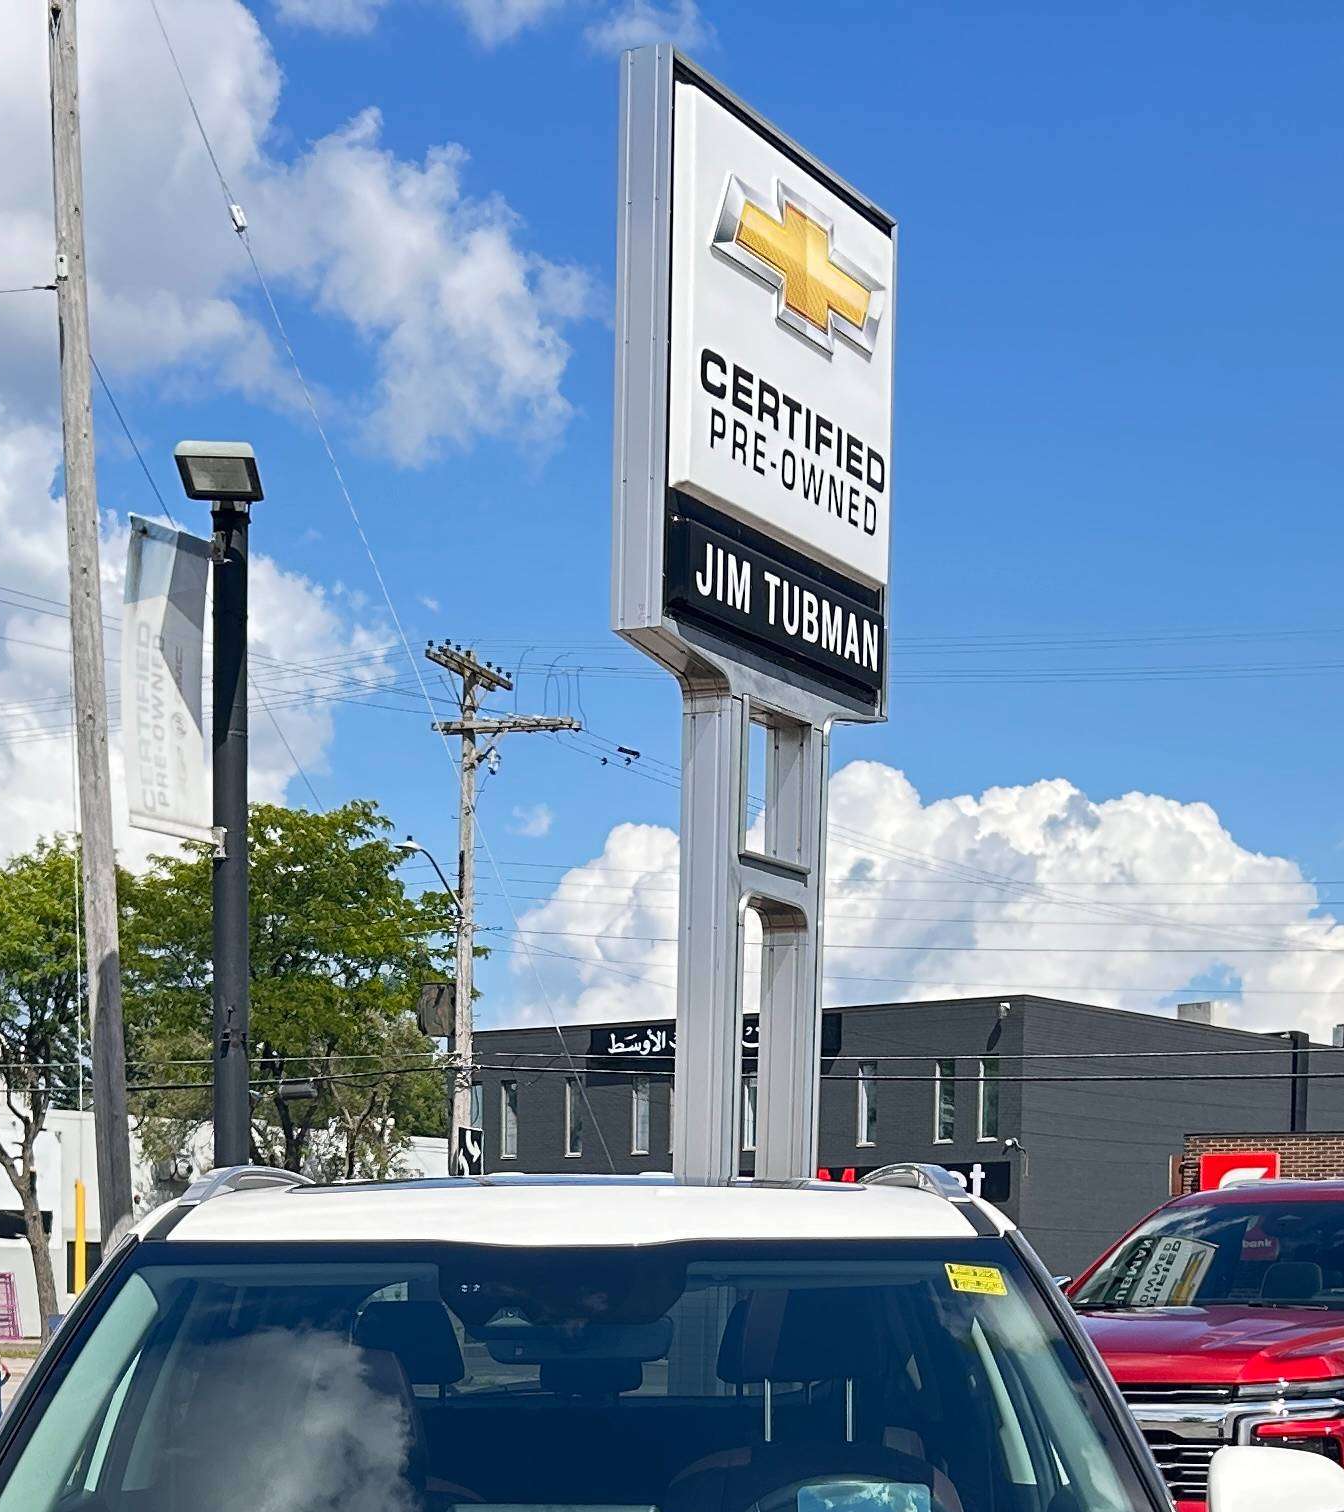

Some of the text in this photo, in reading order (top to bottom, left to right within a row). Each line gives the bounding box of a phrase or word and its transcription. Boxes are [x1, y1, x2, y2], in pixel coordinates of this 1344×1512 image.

[700, 348, 885, 493] CERTIFIED
[710, 407, 877, 537] PRE-OWNED
[696, 543, 879, 672] JIM TUBMAN
[136, 620, 156, 813] CERTIFIED
[151, 634, 171, 808] PRE-OWNED
